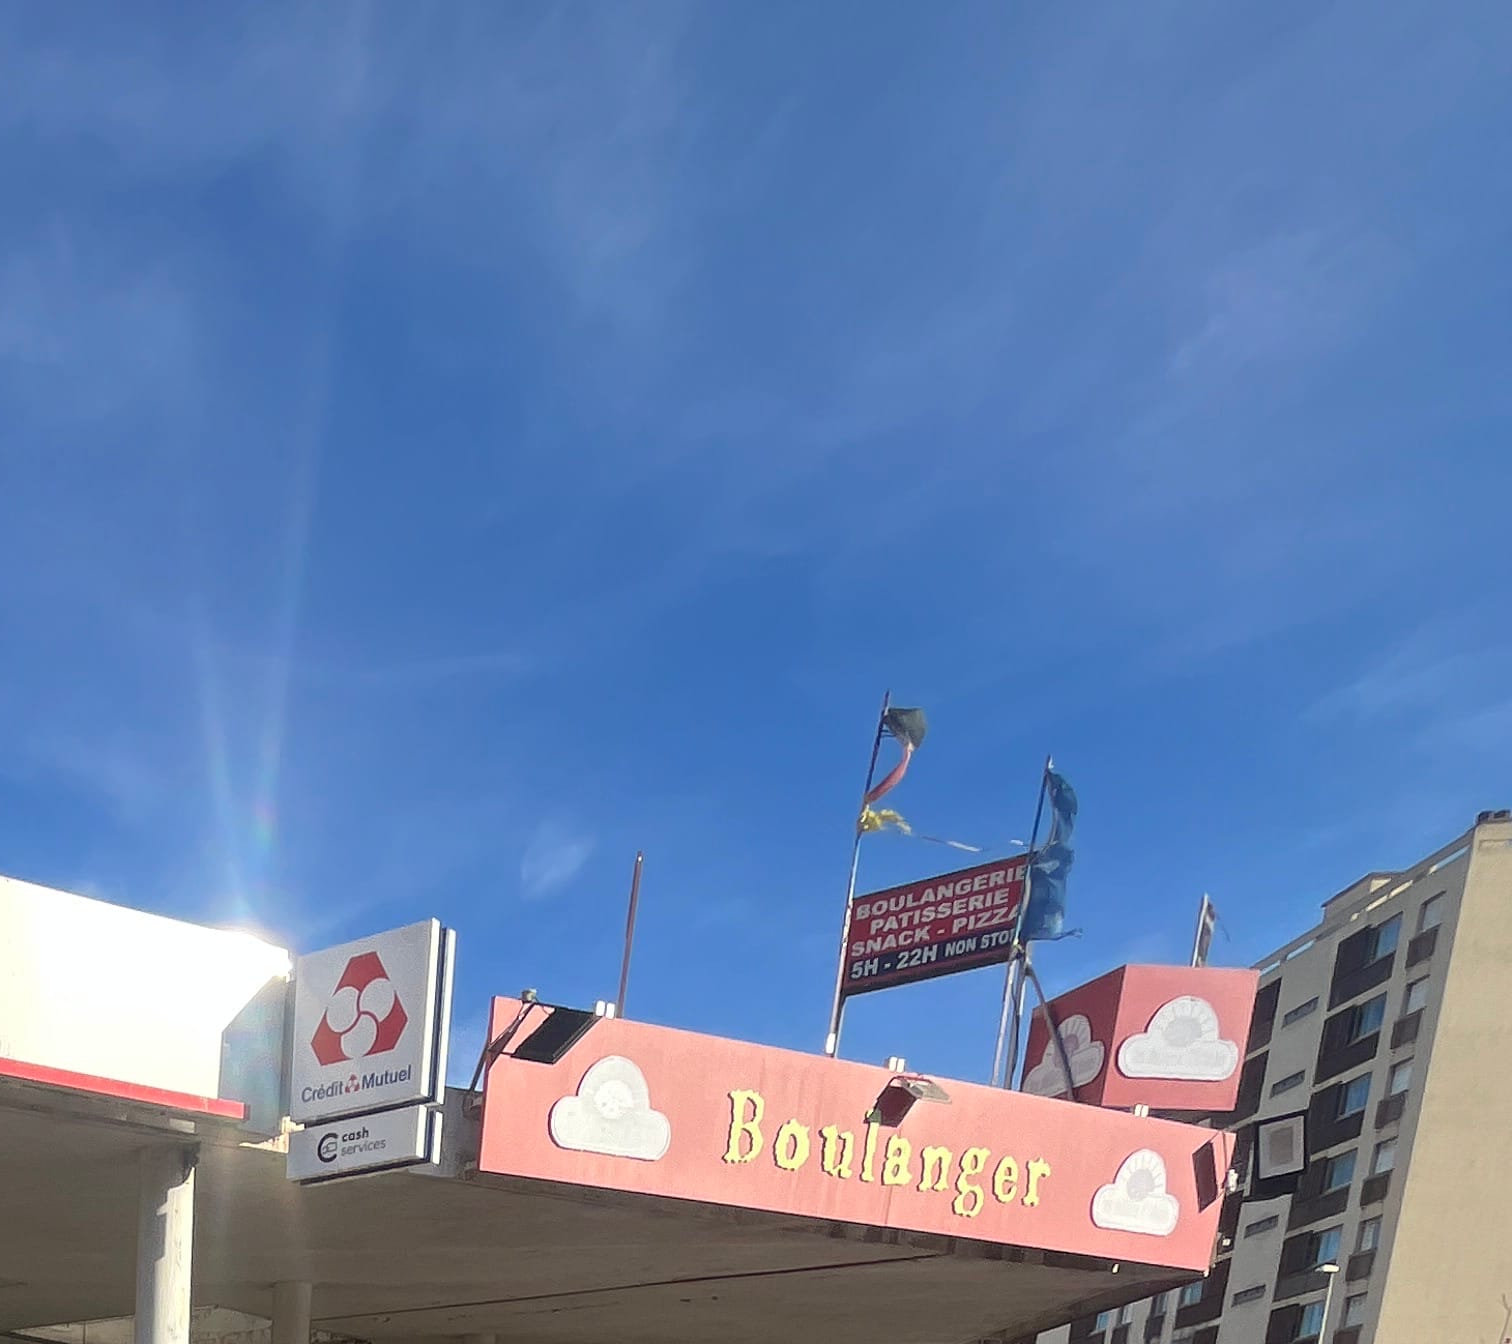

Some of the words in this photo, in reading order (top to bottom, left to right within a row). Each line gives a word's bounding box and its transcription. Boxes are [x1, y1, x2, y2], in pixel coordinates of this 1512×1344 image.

[855, 866, 1027, 920] BOULANGERIE
[870, 888, 1010, 935] PATISSERIE
[850, 958, 879, 979] 5H
[896, 944, 938, 970] 22H
[944, 937, 977, 957] NON
[851, 925, 930, 957] SNACK
[301, 1079, 344, 1103] Crédit
[361, 1064, 412, 1091] Mutuel
[340, 1138, 387, 1156] services
[341, 1126, 369, 1142] cash
[721, 1088, 1052, 1218] Boulanger
